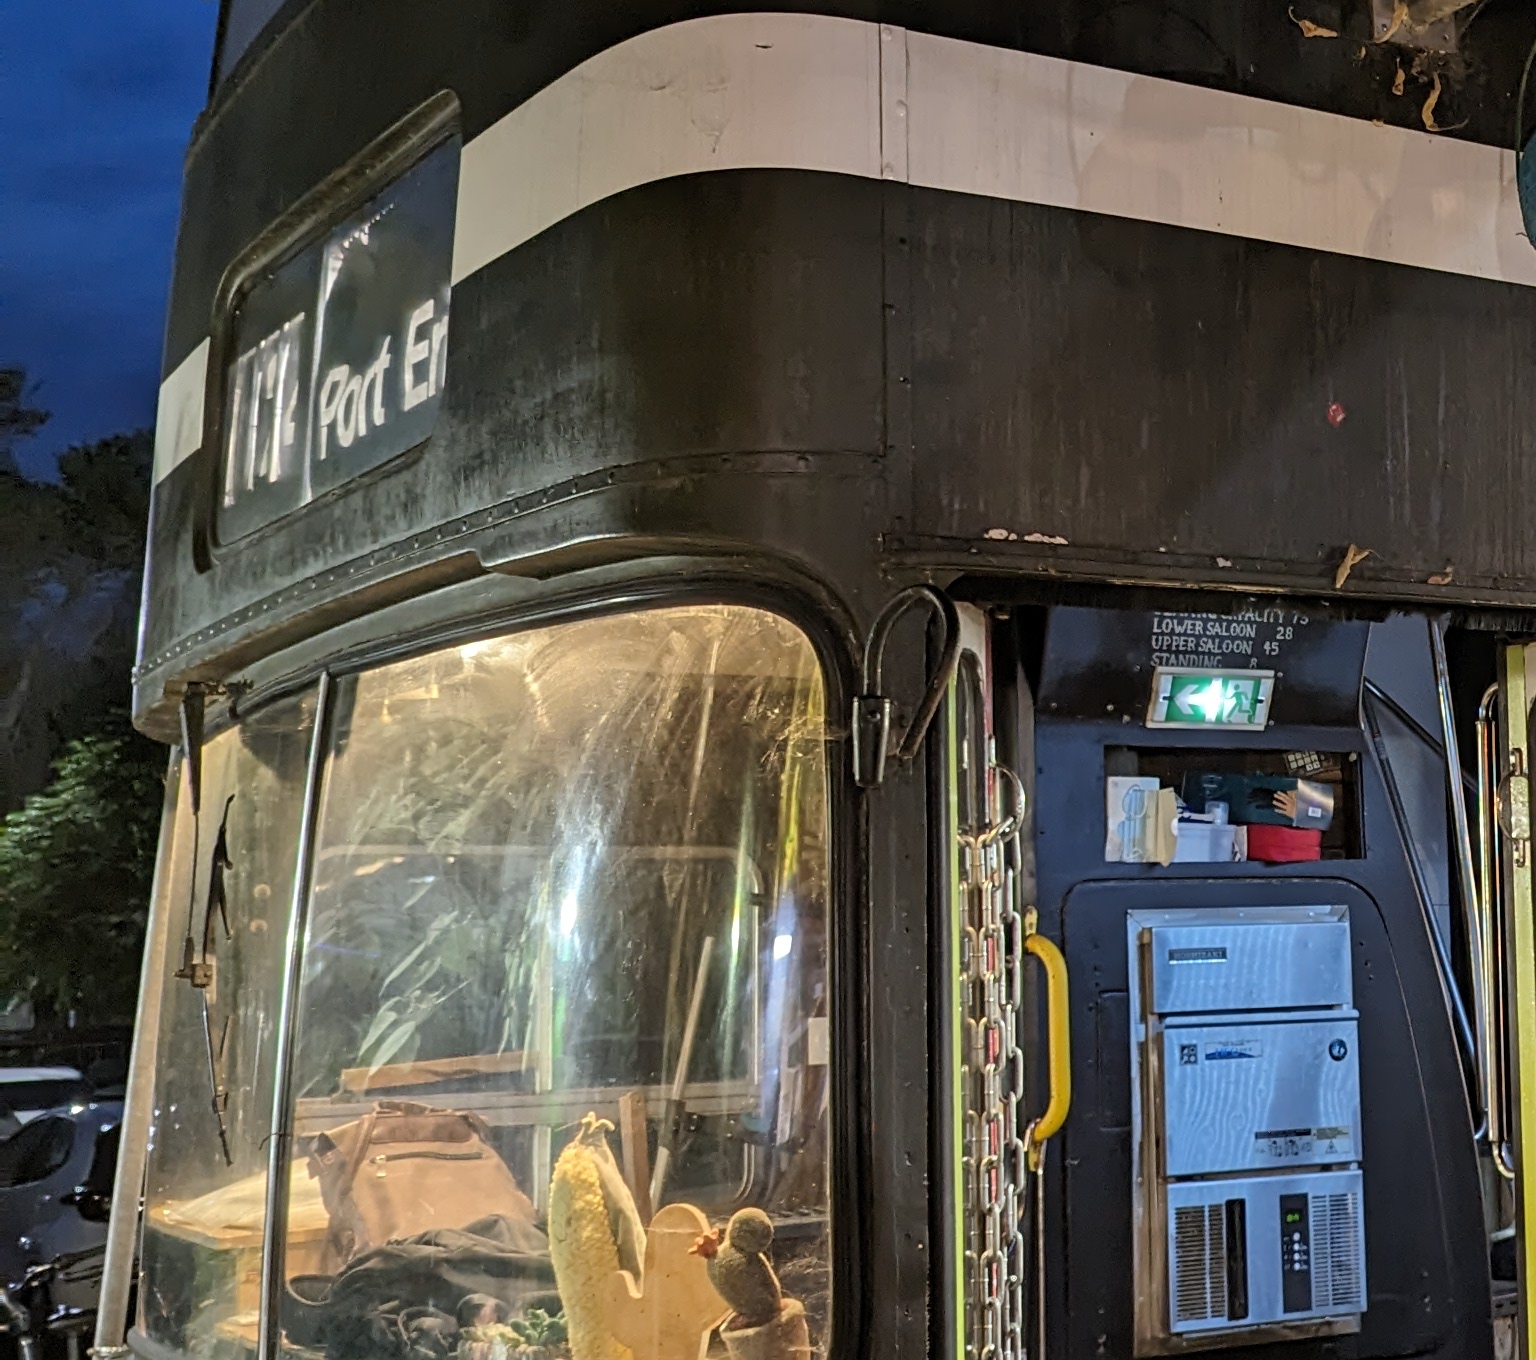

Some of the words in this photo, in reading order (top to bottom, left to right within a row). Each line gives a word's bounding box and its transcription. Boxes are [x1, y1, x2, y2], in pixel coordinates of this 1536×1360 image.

[319, 334, 392, 462] Port
[1152, 618, 1204, 635] LOWER
[1206, 623, 1256, 638] SALOON
[1276, 626, 1294, 640] 28
[1151, 635, 1196, 651] UPPER
[1198, 640, 1253, 655] SALOON
[1263, 642, 1280, 656] 45
[1150, 652, 1223, 668] STANDING
